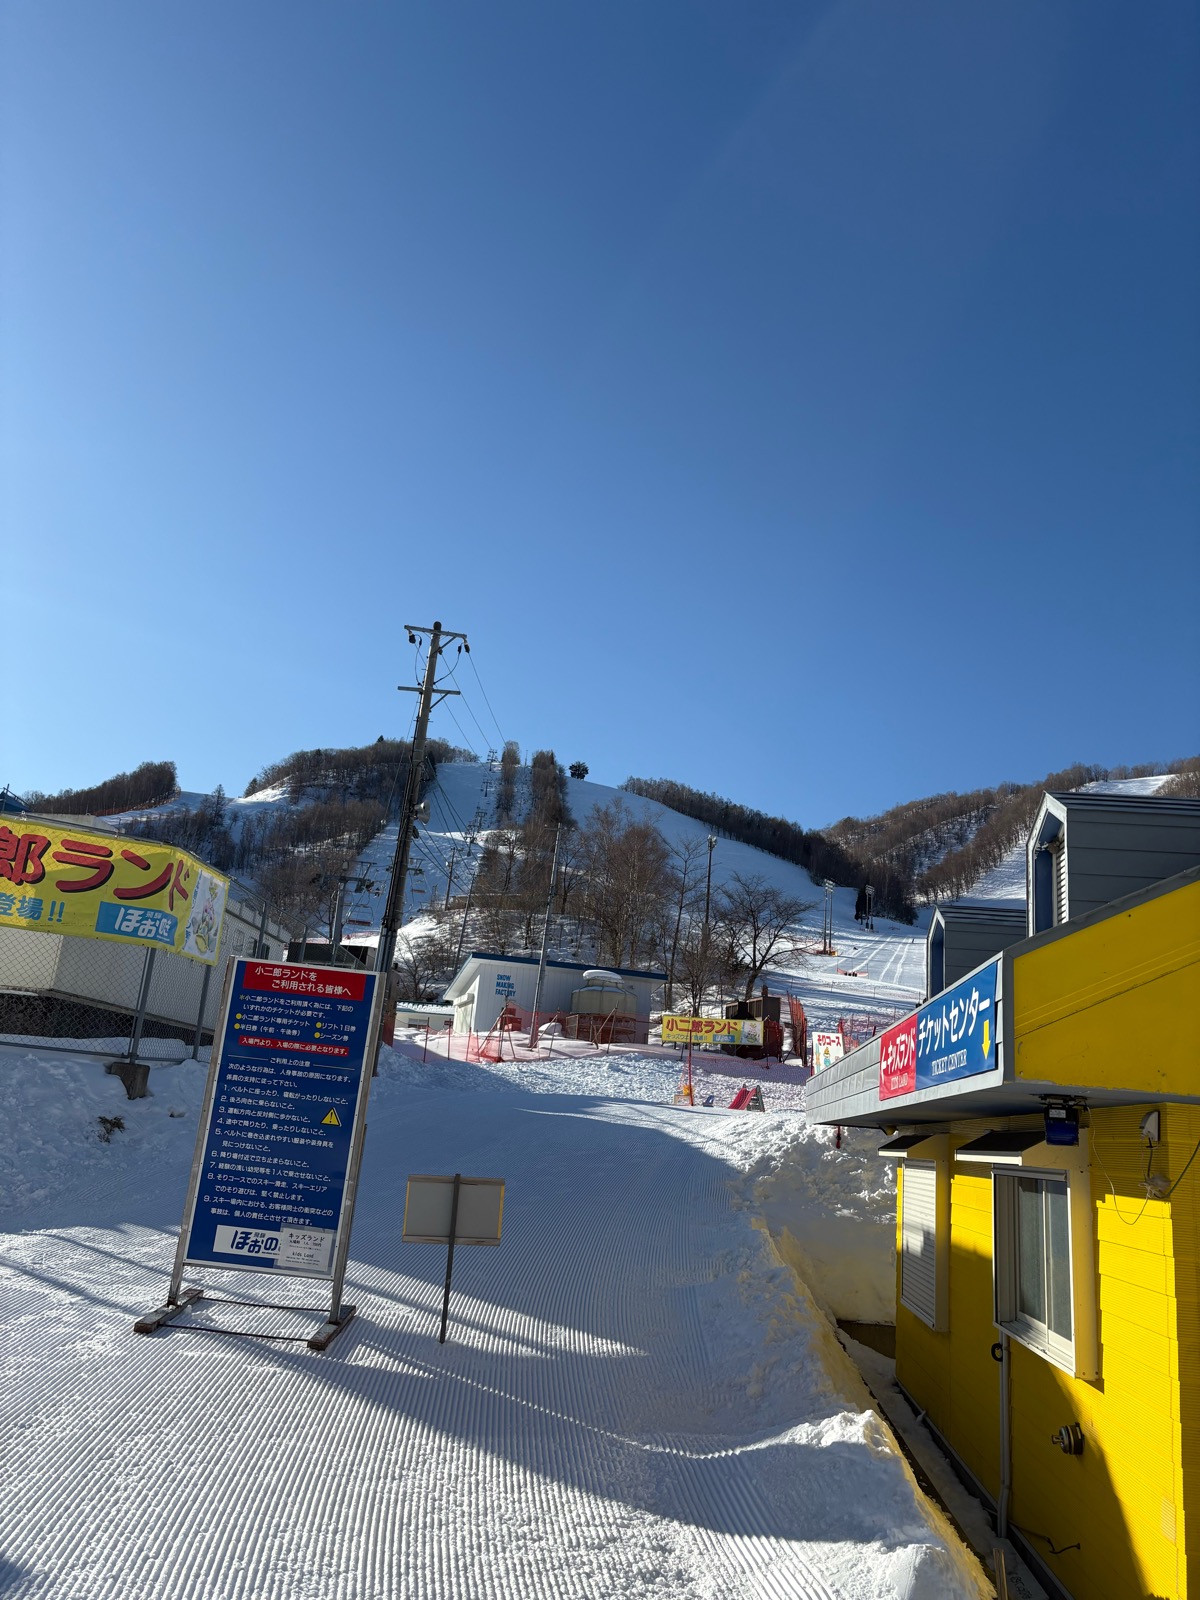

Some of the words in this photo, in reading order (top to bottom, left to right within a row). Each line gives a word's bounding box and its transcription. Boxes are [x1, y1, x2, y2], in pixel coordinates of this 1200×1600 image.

[255, 966, 317, 980] 小二郎ランドを
[271, 979, 351, 995] ご利用される皆様へ
[496, 982, 514, 990] MAKING
[496, 989, 516, 997] FACTORY
[243, 1004, 326, 1018] いずれかのチケットが必要です。
[666, 1018, 738, 1034] 小二郎ランド
[918, 987, 990, 1058] チケットセンター
[320, 1032, 348, 1041] シーズン券
[817, 1035, 842, 1048] そりコース
[888, 1027, 916, 1074] キッズランド
[270, 1057, 310, 1067] ご利用上の注意
[932, 1056, 948, 1076] TICKET
[948, 1048, 968, 1072] CENTER
[230, 1230, 281, 1254] ほおの
[288, 1232, 325, 1242] キッズランド
